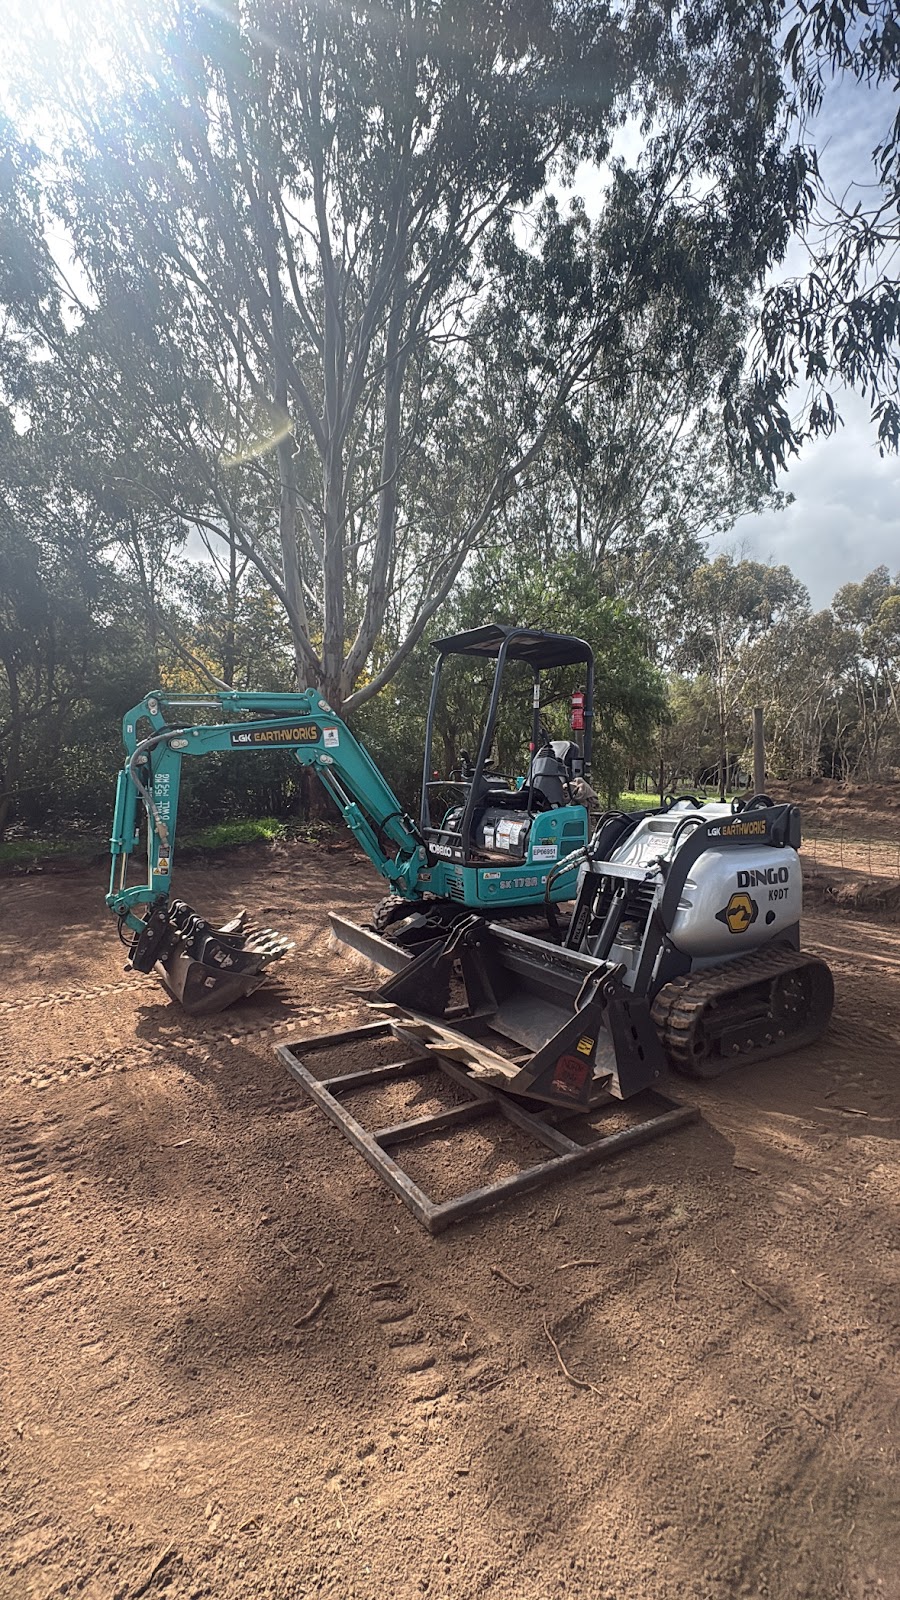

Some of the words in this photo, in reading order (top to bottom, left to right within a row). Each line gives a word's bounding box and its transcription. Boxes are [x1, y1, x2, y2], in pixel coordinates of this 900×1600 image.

[232, 734, 251, 742] LGK
[254, 726, 317, 741] EARTHWORKS
[707, 827, 721, 836] LGK
[722, 820, 766, 835] EARTHWORKS
[768, 887, 789, 901] K9DT
